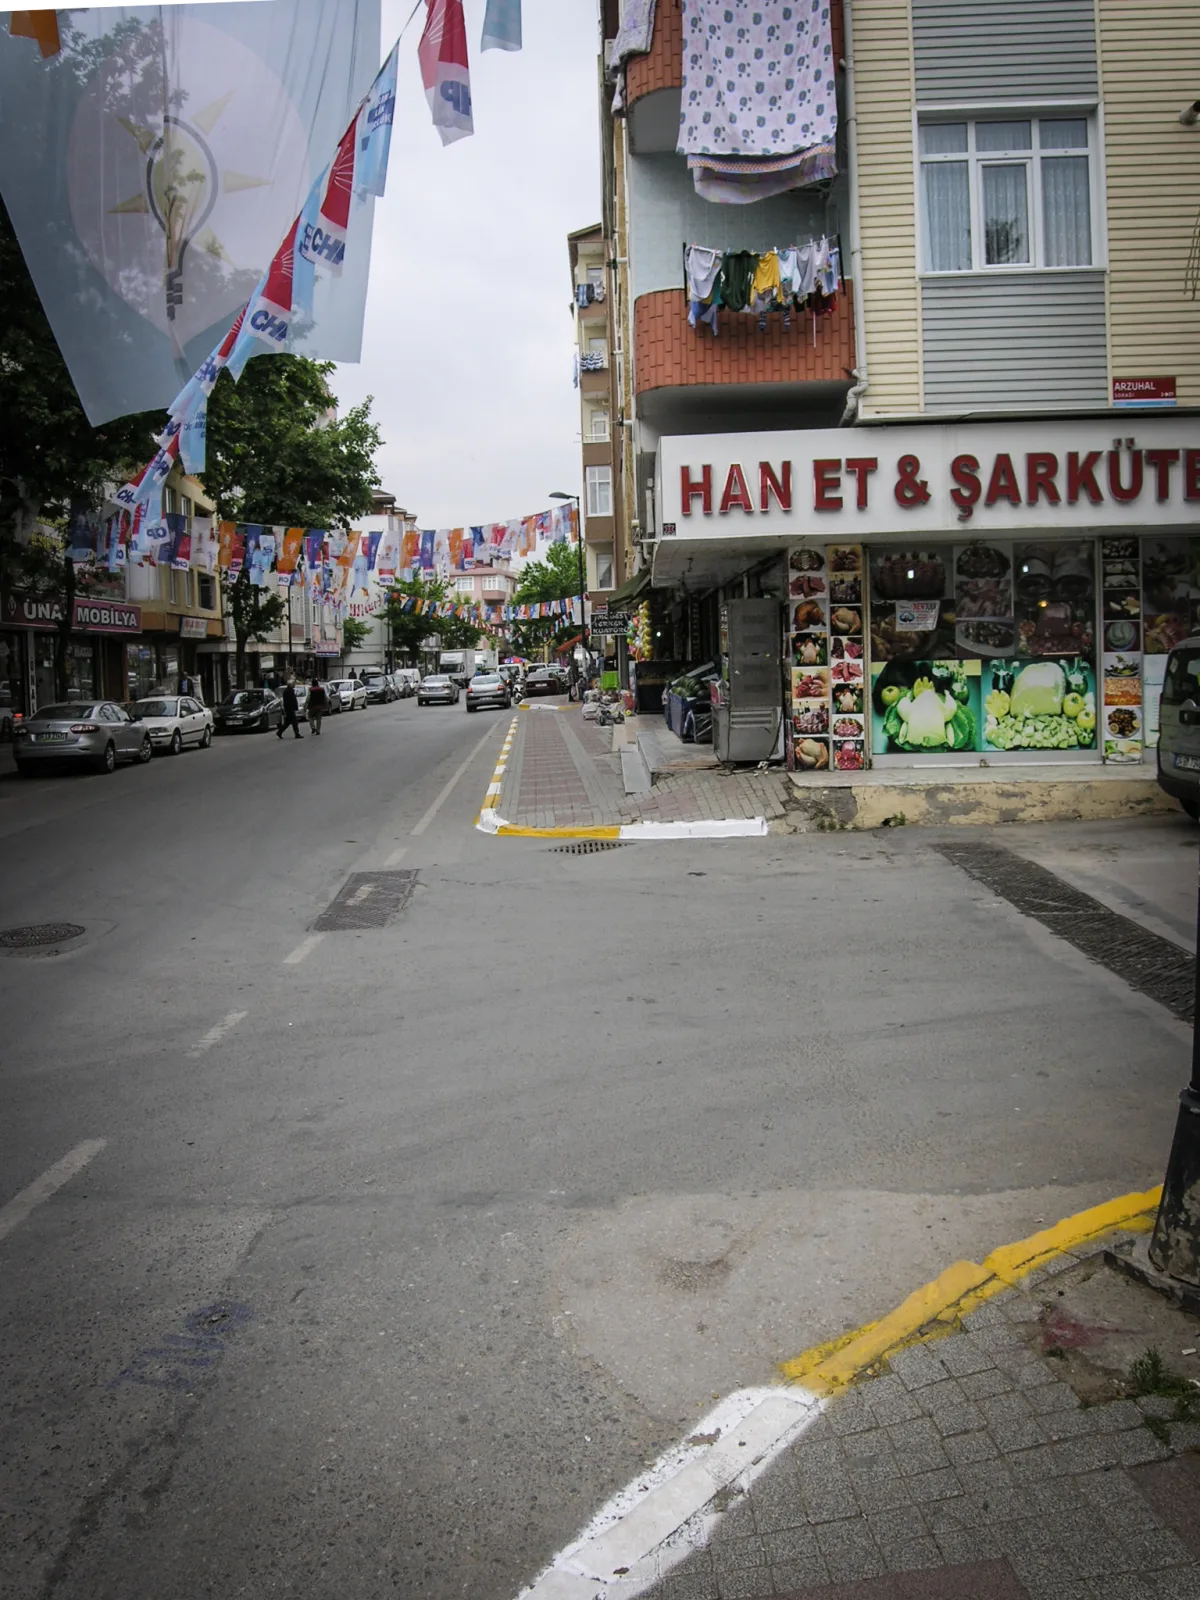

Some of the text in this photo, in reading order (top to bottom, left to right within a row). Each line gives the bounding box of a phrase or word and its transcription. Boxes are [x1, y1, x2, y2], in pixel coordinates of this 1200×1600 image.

[1114, 382, 1156, 391] ARZUHAL
[680, 460, 793, 516] HAN
[813, 456, 878, 512] ET
[894, 454, 932, 508] &
[77, 606, 138, 627] MOBİLYA
